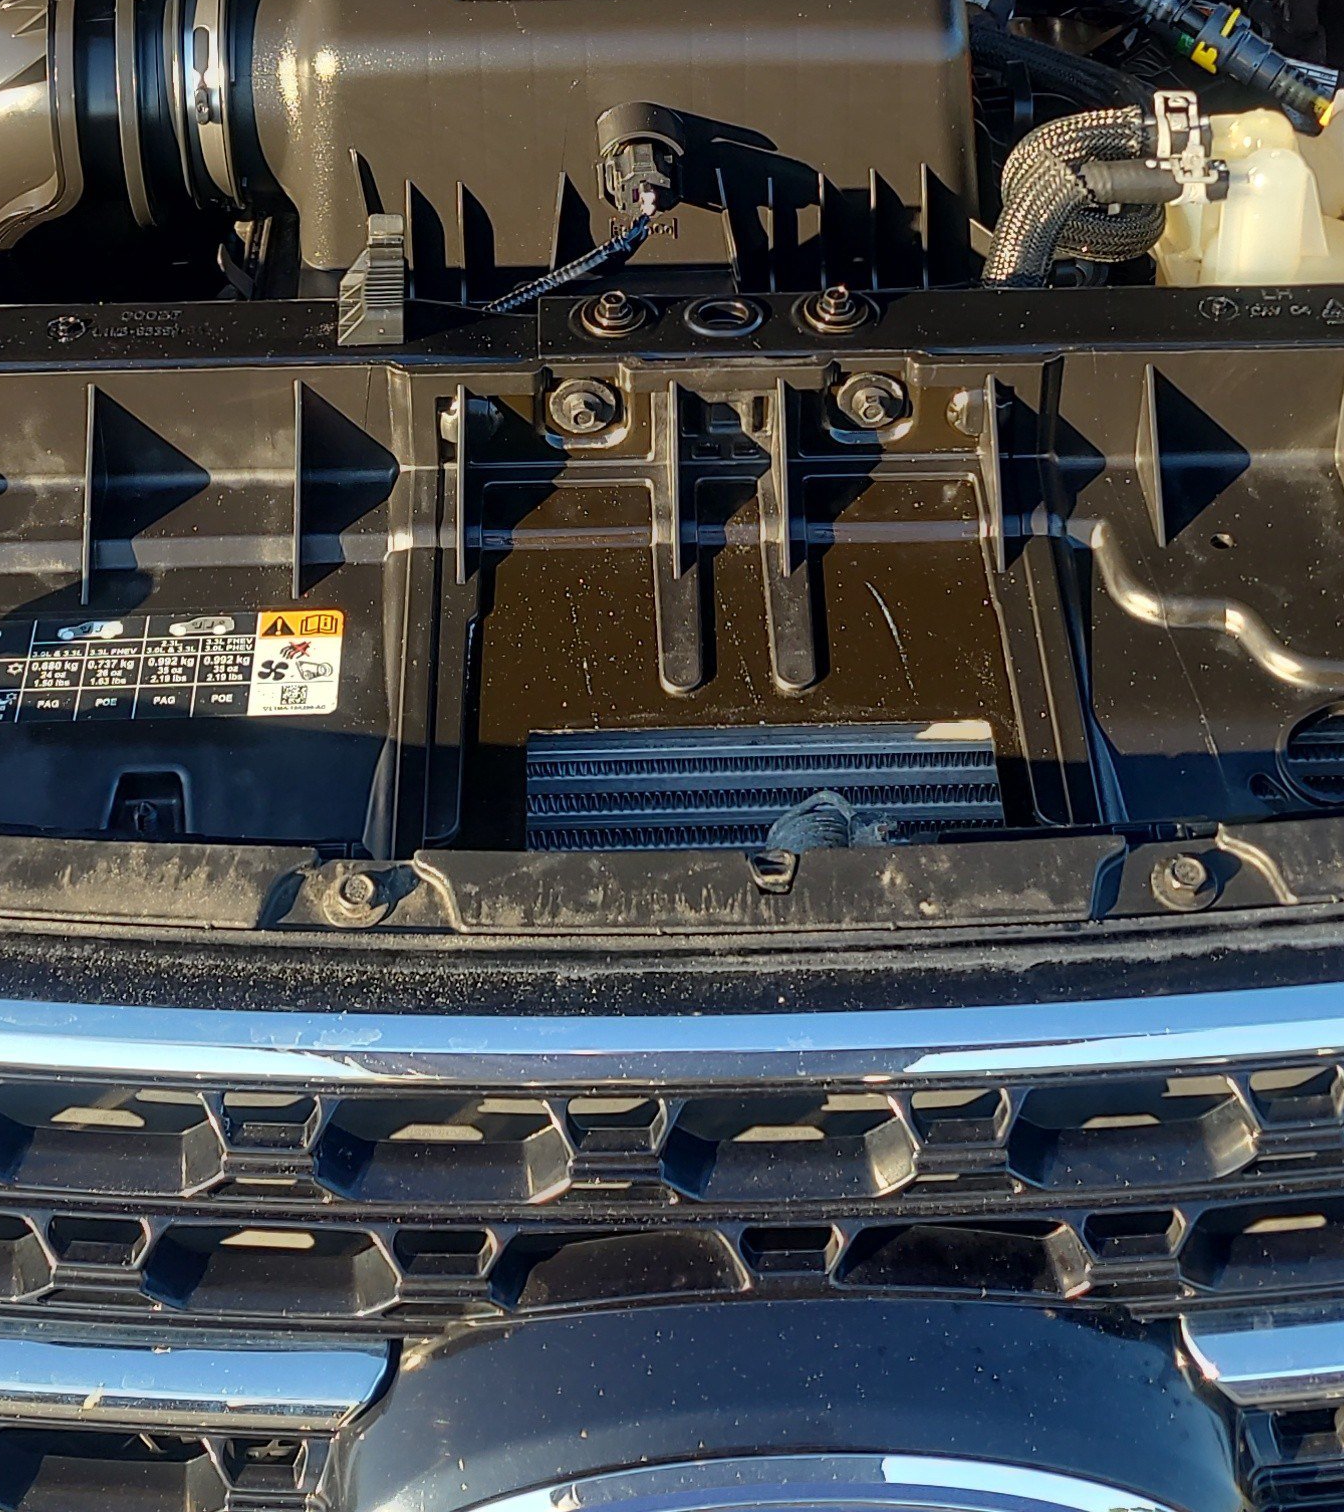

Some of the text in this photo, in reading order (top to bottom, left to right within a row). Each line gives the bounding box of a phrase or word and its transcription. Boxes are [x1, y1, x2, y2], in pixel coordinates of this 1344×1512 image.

[87, 659, 135, 670] 0.737 kg
[148, 656, 195, 667] 0.992 kg
[203, 655, 250, 666] 0.992 kg
[64, 660, 79, 672] kg
[40, 671, 52, 679] 24
[172, 674, 187, 682] lbs
[206, 673, 227, 681] 2.19
[95, 698, 117, 706] POE
[153, 696, 176, 705] PAG
[211, 694, 233, 703] POE
[37, 700, 60, 708] PAG
